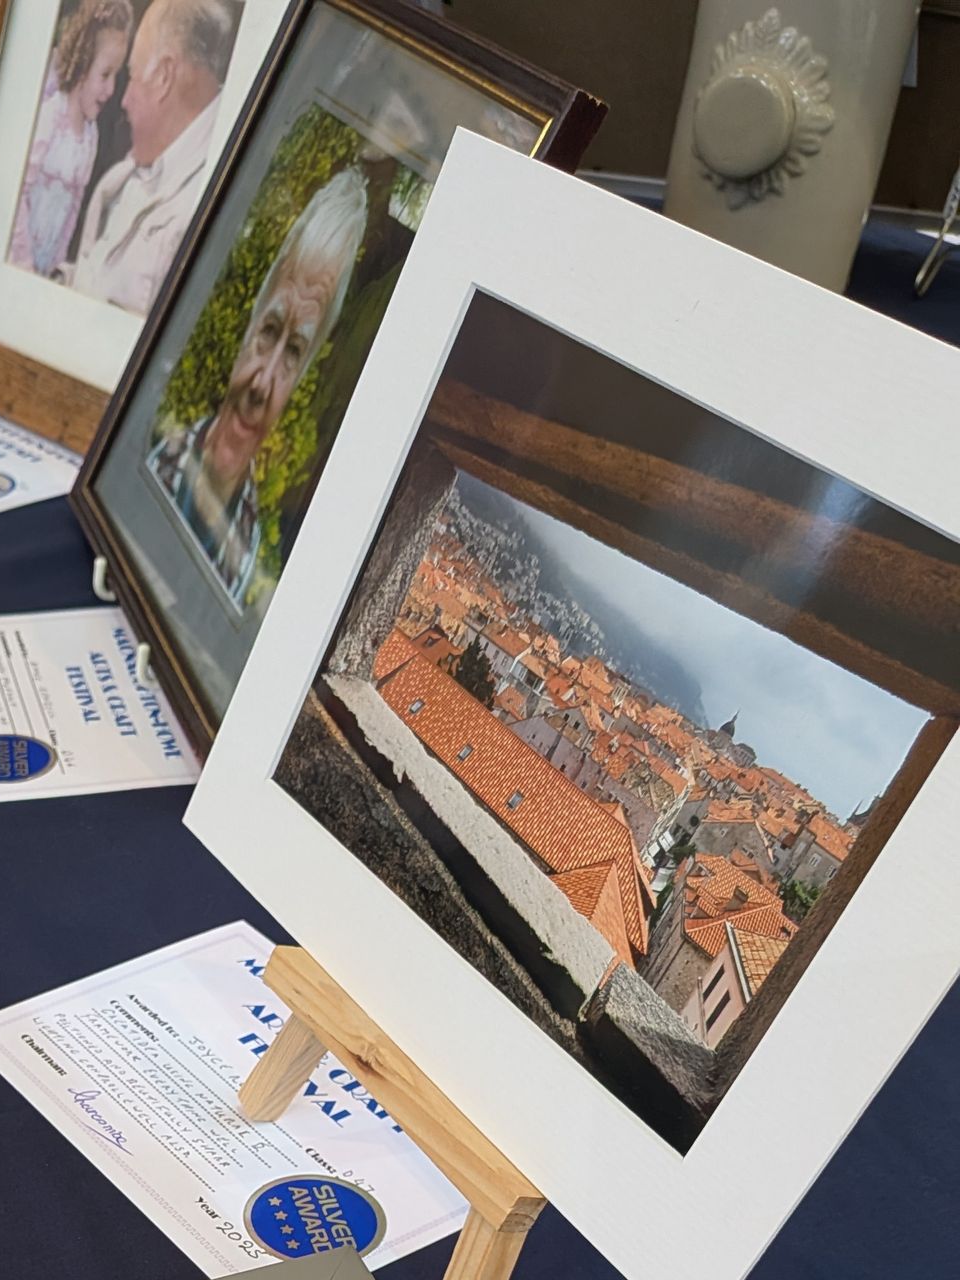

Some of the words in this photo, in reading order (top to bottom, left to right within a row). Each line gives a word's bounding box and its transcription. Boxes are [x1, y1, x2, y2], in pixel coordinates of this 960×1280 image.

[12, 738, 30, 778] SILVER
[109, 999, 160, 1044] Comments:
[20, 1033, 68, 1077] Chairman:
[304, 1147, 337, 1174] Class:
[195, 1196, 222, 1220] Year
